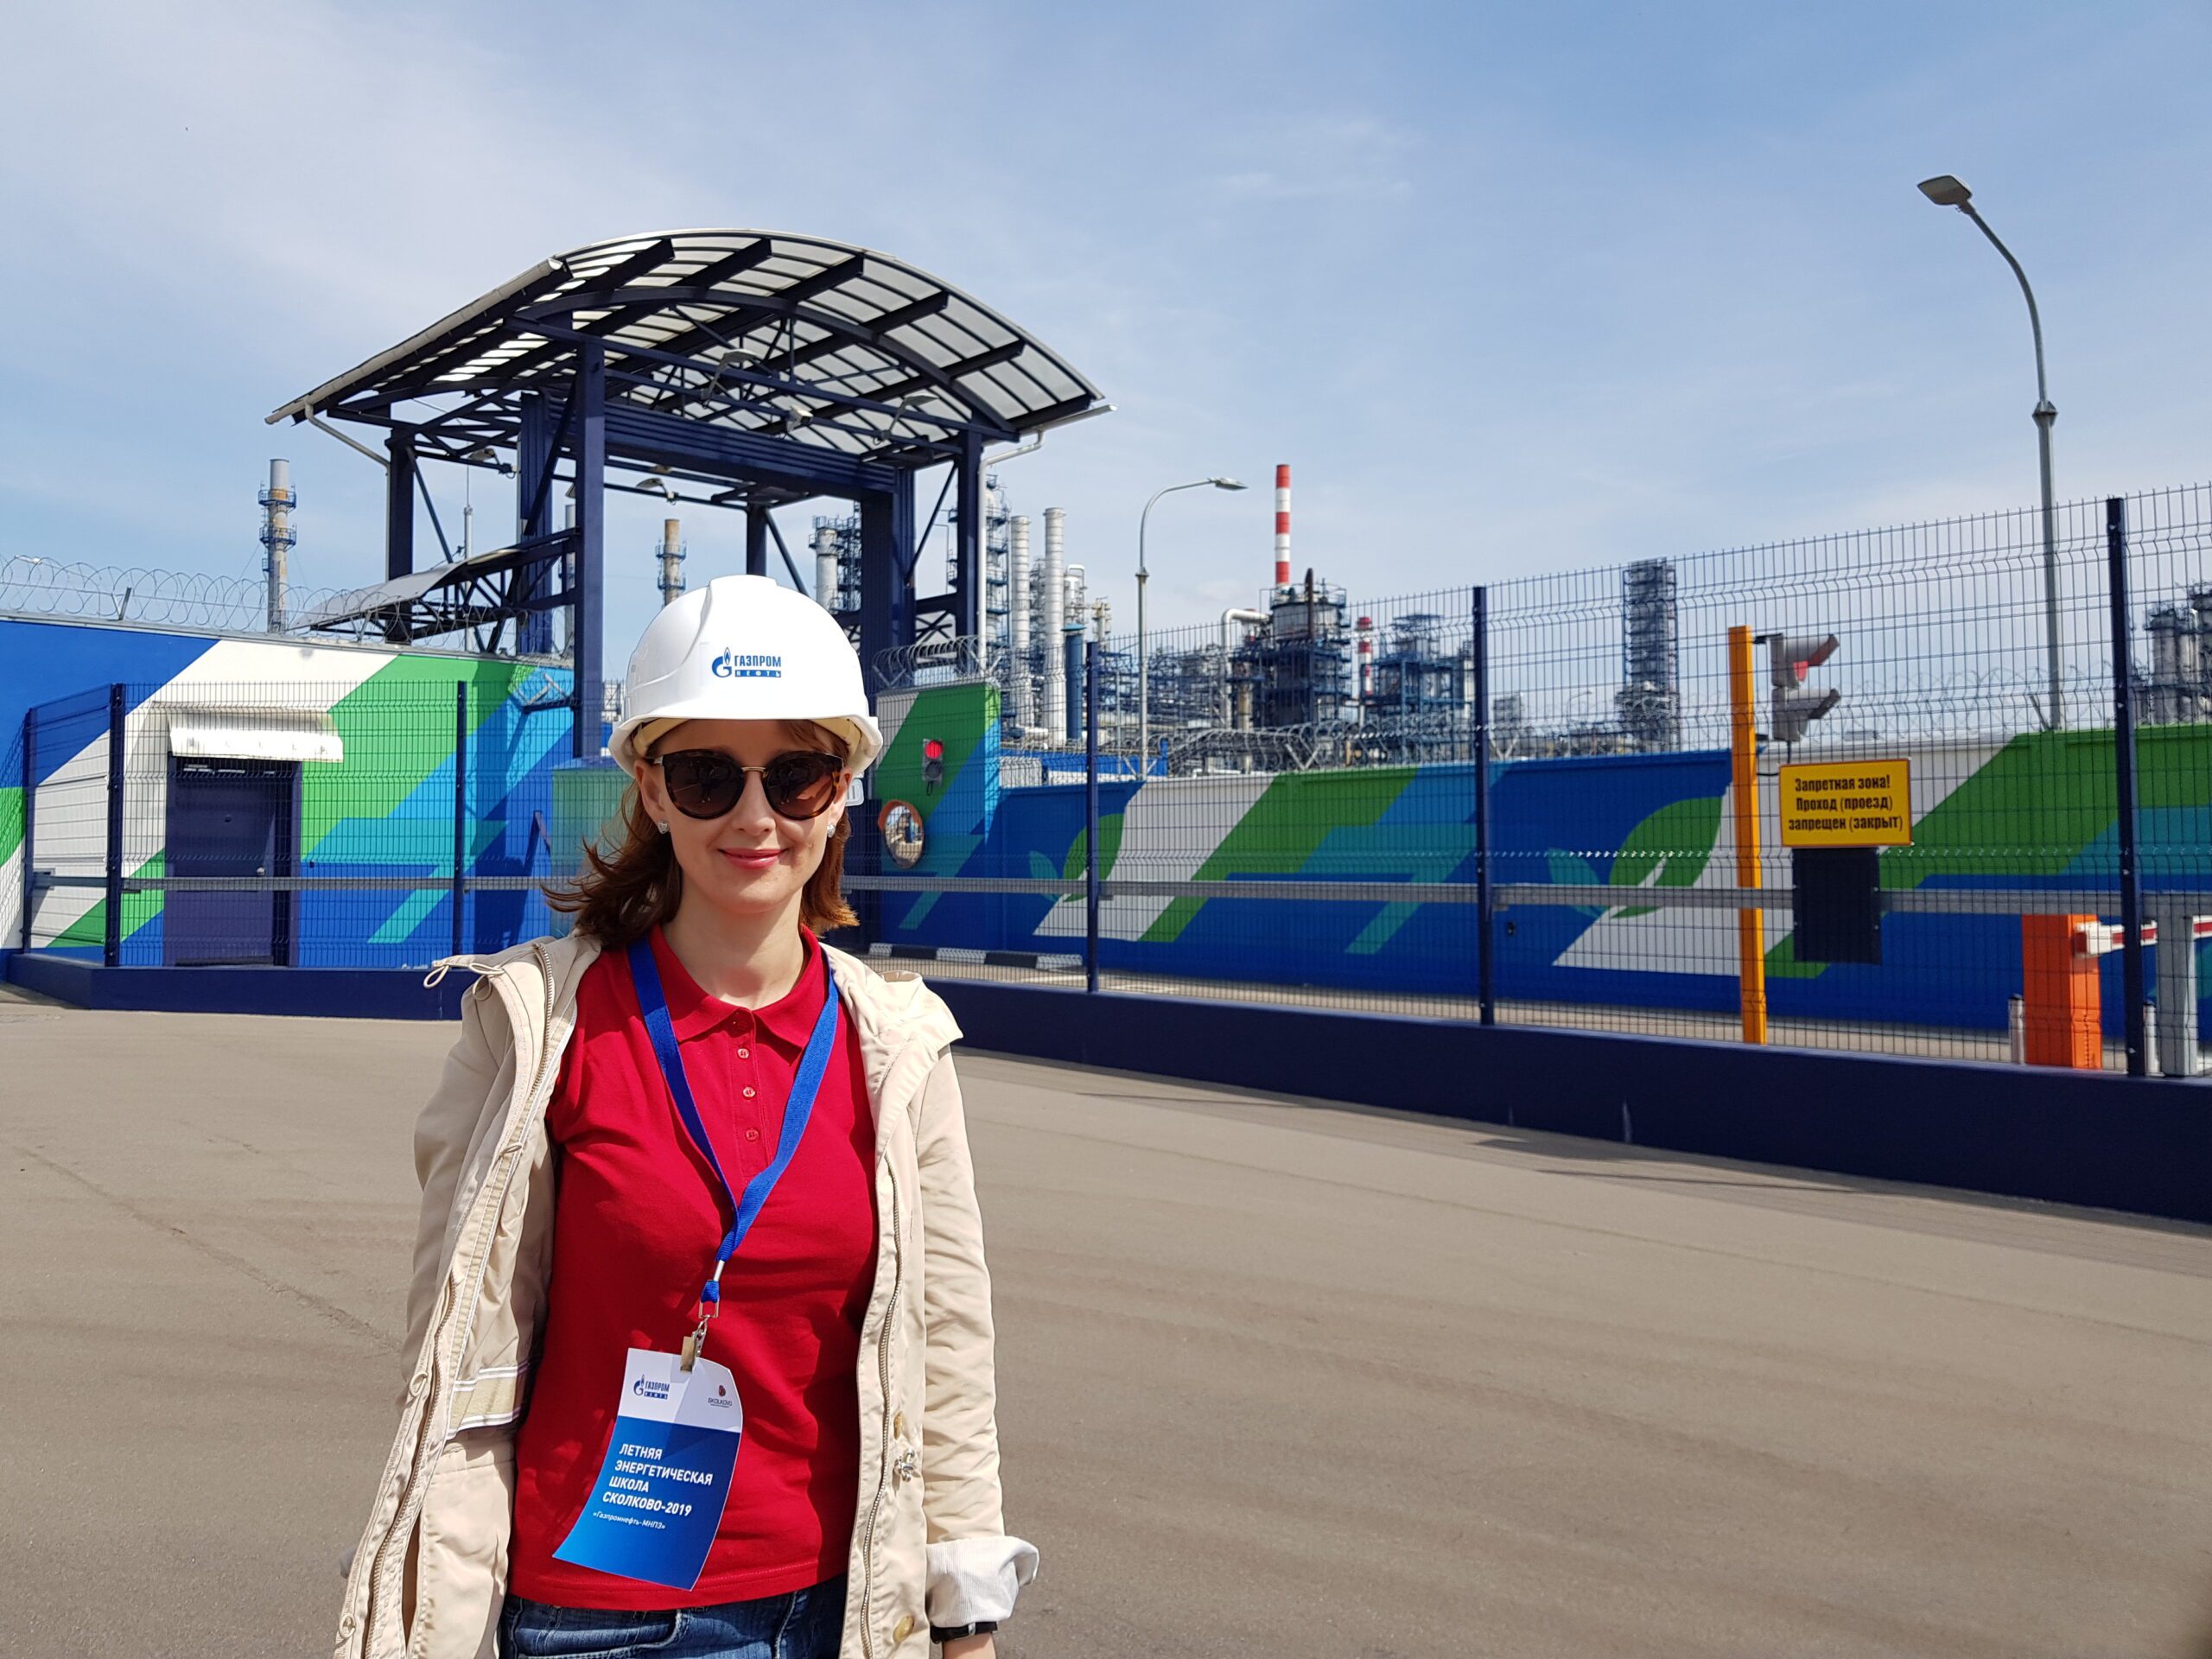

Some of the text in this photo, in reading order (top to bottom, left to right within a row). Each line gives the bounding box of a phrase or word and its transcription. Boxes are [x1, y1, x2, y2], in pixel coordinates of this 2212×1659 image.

[734, 655, 781, 667] ГАЗПРОМ
[1795, 775, 1890, 792] Запретная зона!
[1796, 796, 1893, 813] Проход (проезд)
[1789, 816, 1904, 832] запрещен (закрыт)
[645, 1381, 671, 1392] ГАЗПРОМ
[619, 1443, 664, 1460] ЛЕТНЯЯ
[614, 1459, 714, 1486] ЭНЕРГЕТИЧЕСКАЯ
[608, 1475, 650, 1493] ШКОЛА
[602, 1491, 692, 1517] СКОЛКОВО-2019
[593, 1511, 665, 1529] «Газпромнефть-МНПЗ»
